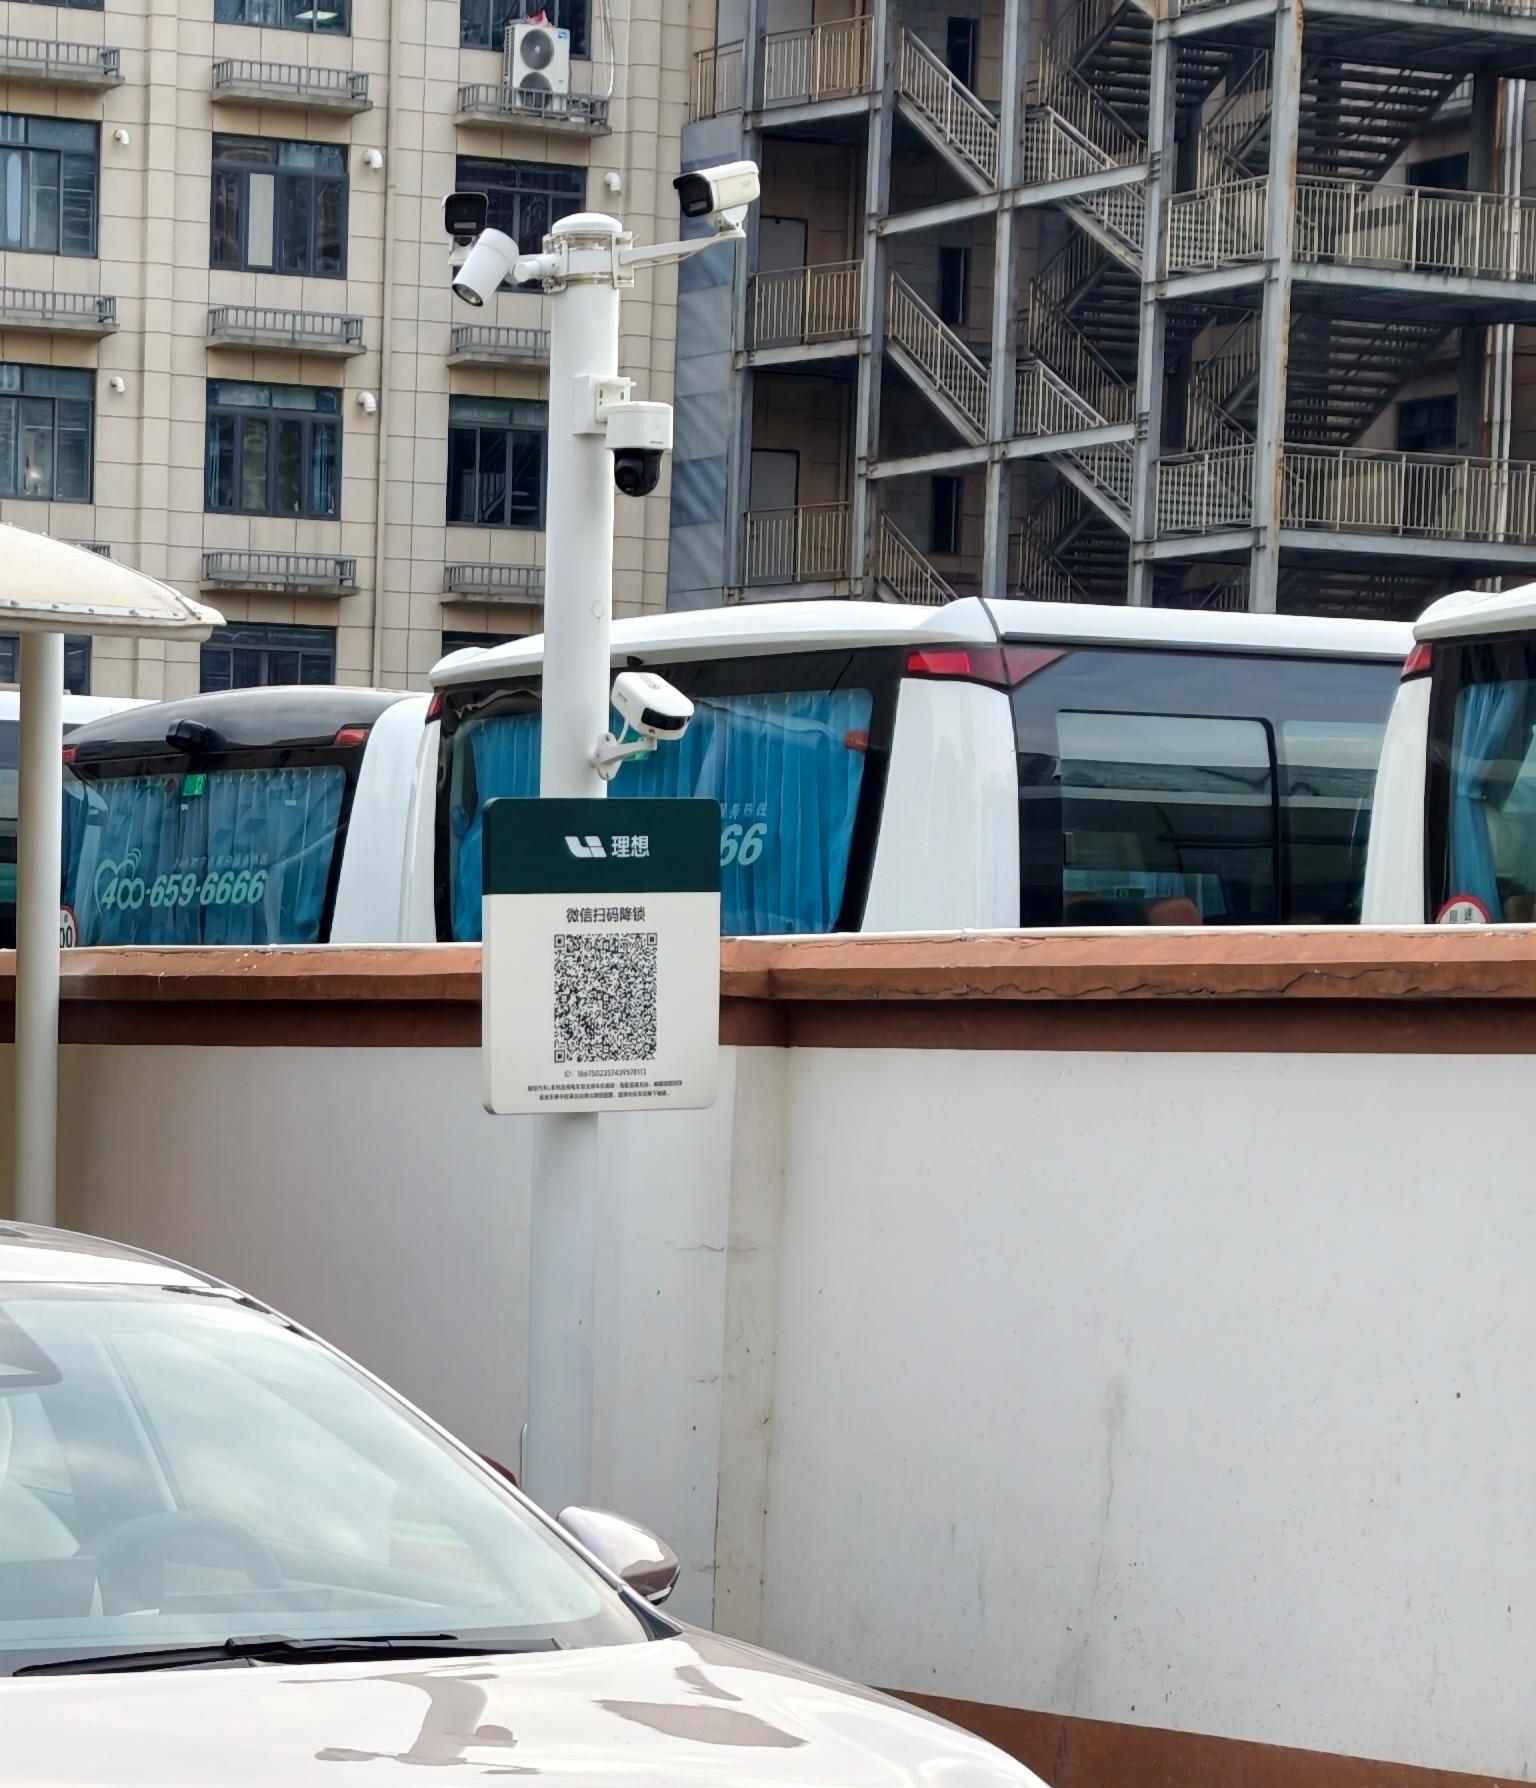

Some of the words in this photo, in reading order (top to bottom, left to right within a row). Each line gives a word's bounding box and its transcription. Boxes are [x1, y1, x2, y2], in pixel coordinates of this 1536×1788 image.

[611, 835, 650, 858] 理想
[101, 869, 269, 911] 400-659-6666
[566, 906, 646, 923] 微信扫码降锁
